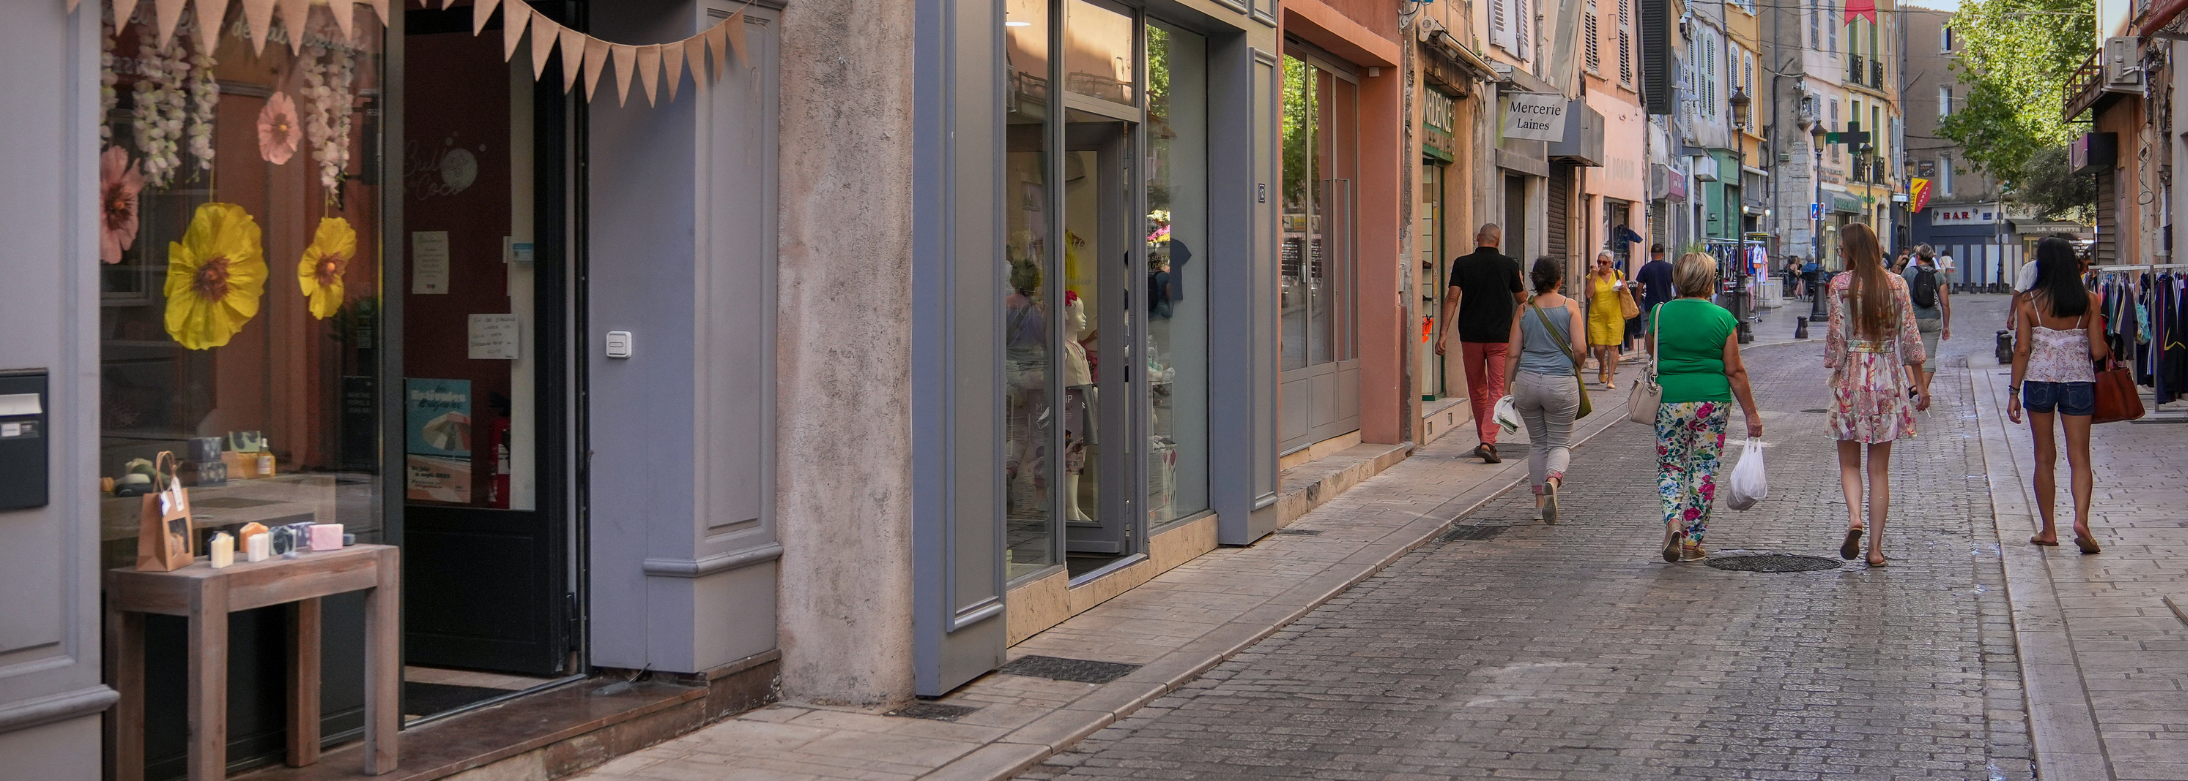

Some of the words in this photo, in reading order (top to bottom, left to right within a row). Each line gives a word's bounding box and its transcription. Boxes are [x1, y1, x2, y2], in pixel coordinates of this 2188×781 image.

[1423, 86, 1452, 133] NFIDENCE
[1510, 101, 1561, 116] Mercerie
[1517, 118, 1550, 131] Laines
[1918, 186, 1929, 207] TABAC
[1943, 211, 1970, 220] BAR
